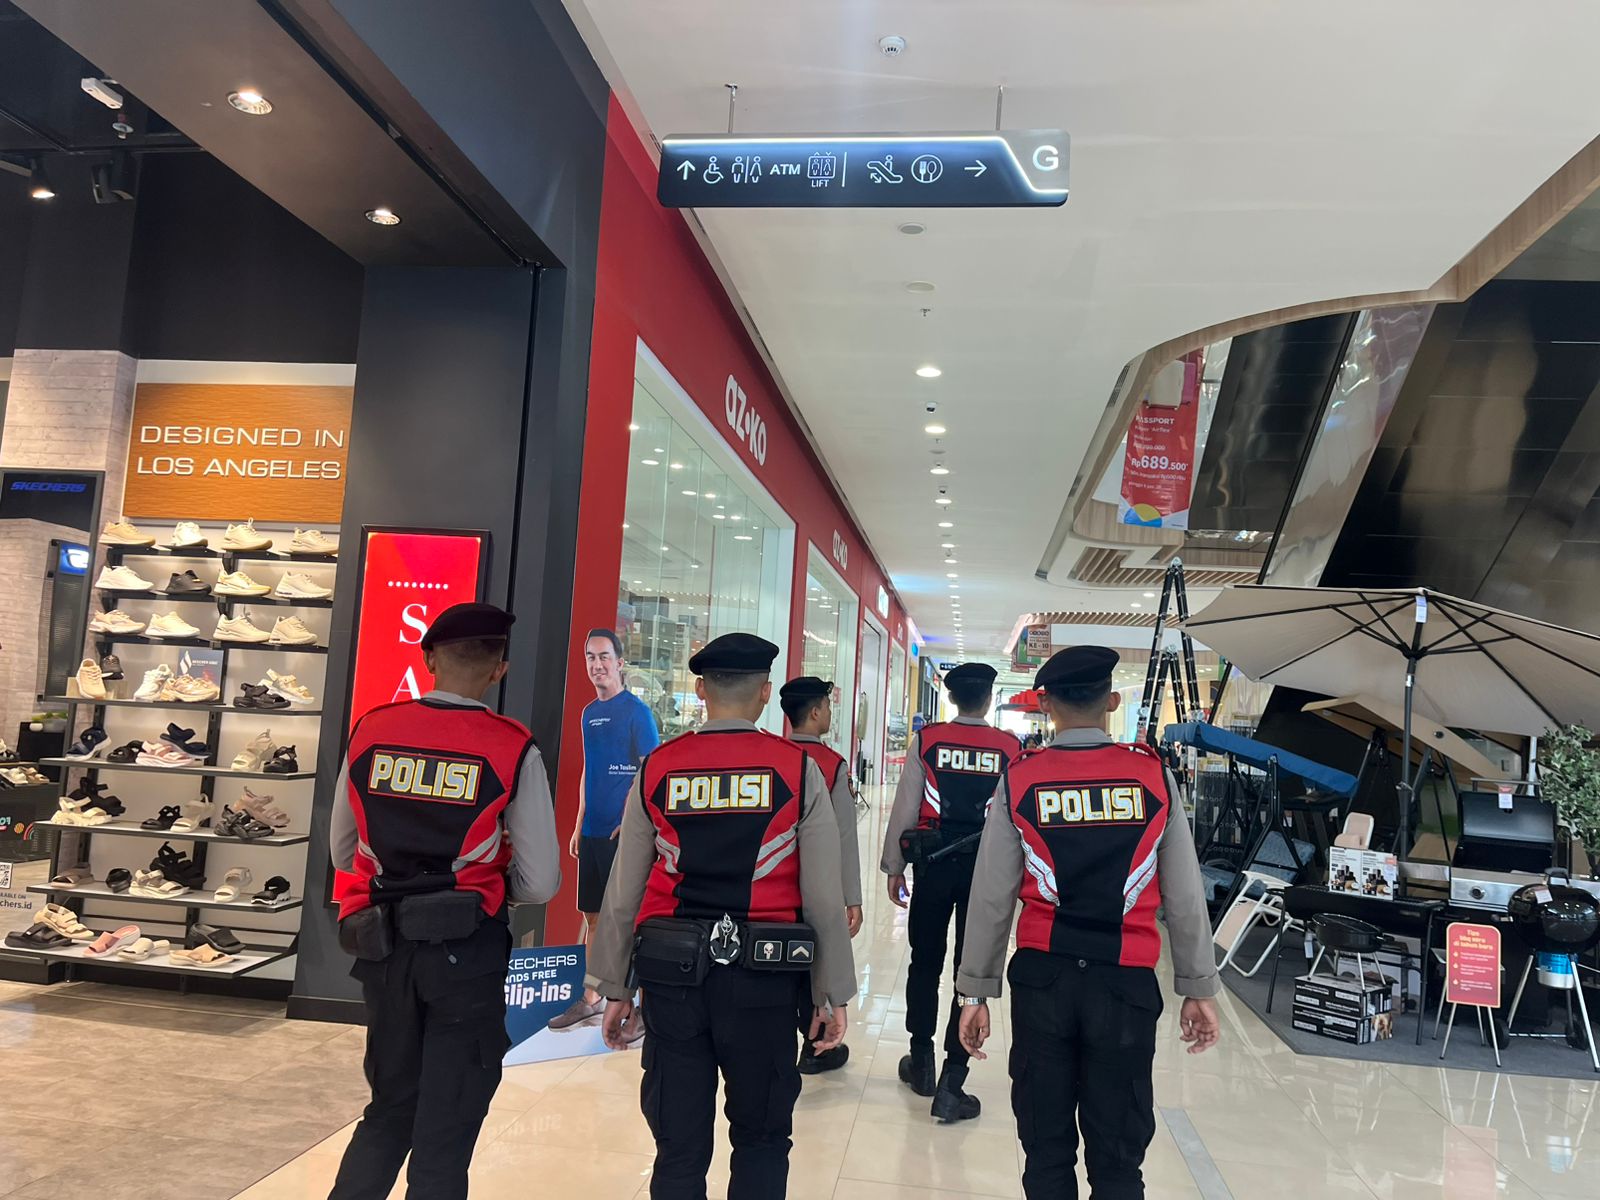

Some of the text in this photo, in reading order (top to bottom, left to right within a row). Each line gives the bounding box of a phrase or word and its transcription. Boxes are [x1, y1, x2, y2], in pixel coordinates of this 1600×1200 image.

[769, 163, 801, 175] ATM
[1032, 144, 1059, 171] G
[811, 179, 829, 188] LIFT
[1135, 415, 1175, 425] PASSPORT
[140, 425, 344, 448] DESIGNED IN
[137, 456, 341, 479] LOS ANGELES
[10, 481, 87, 493] SKECHERS
[937, 748, 1000, 774] POLISI
[370, 754, 479, 800] POLISI
[667, 774, 771, 810] POLISI
[1038, 787, 1144, 823] POLISI
[508, 954, 578, 970] KECHERS
[532, 969, 557, 980] FREE
